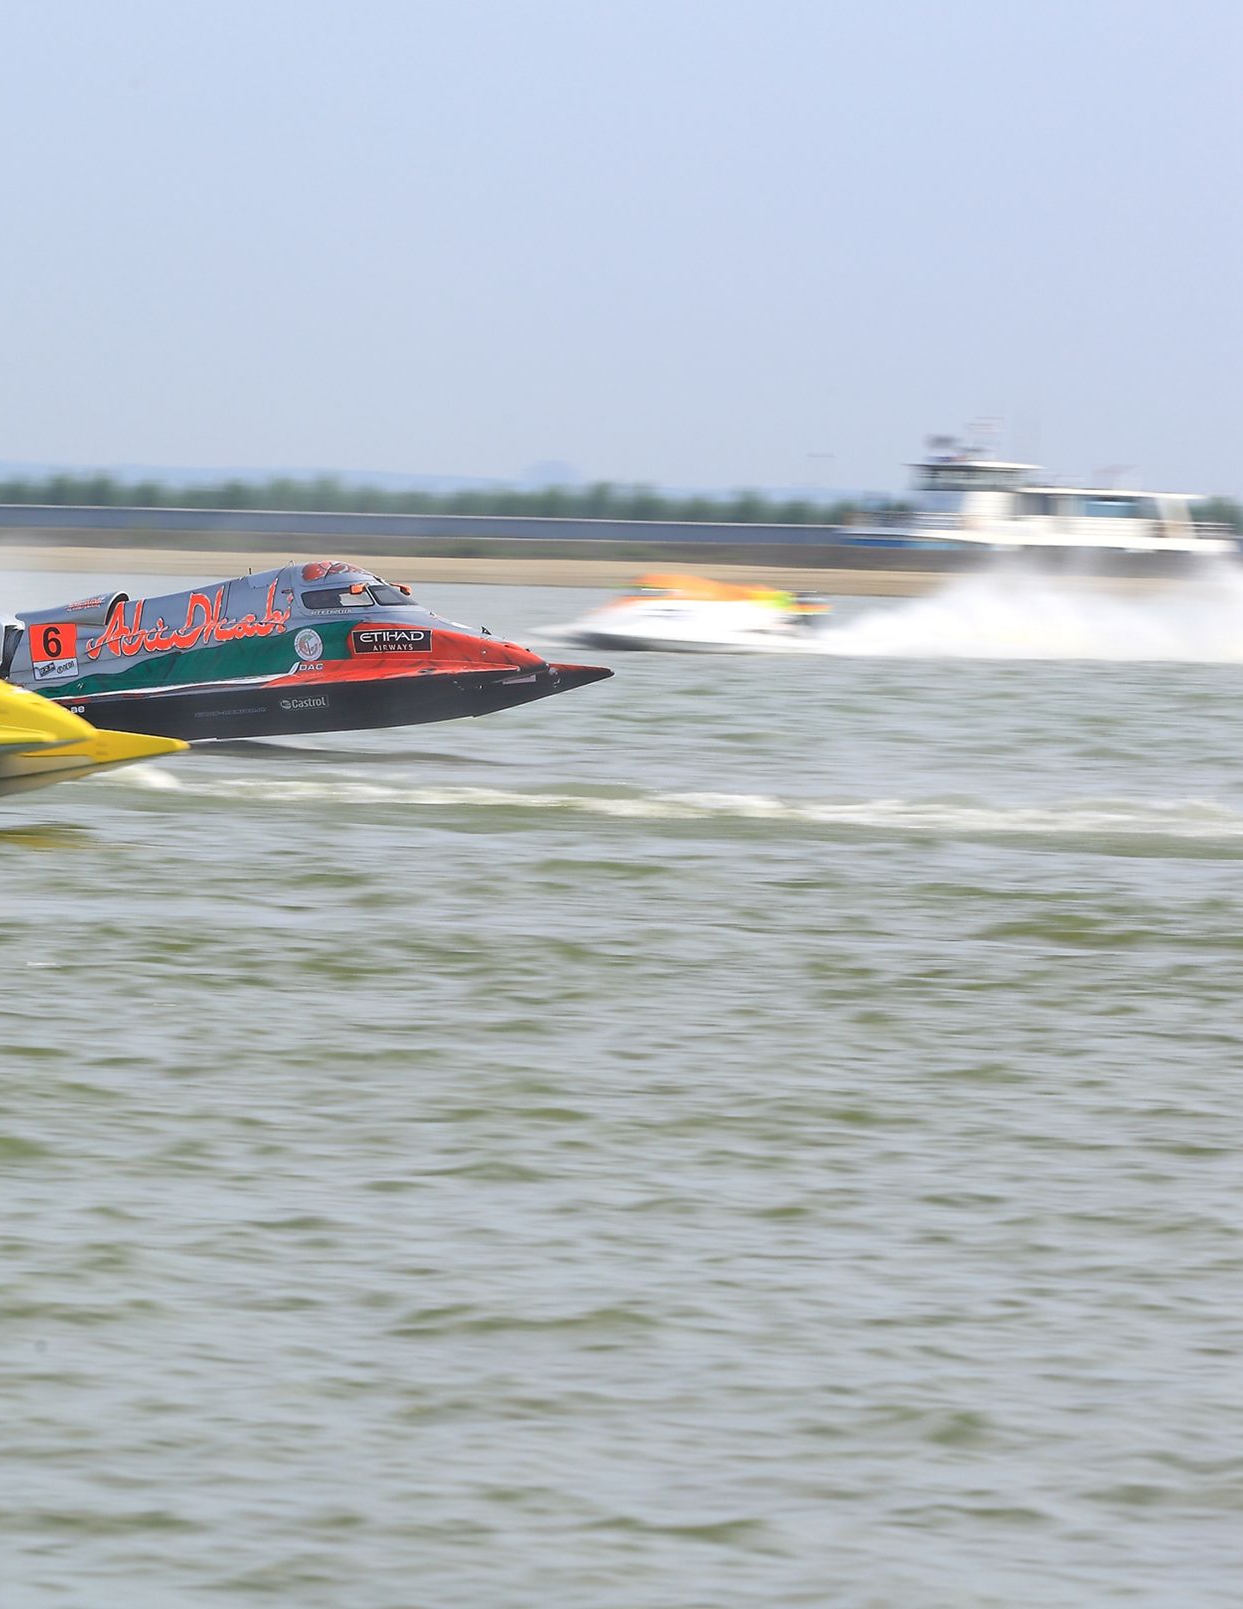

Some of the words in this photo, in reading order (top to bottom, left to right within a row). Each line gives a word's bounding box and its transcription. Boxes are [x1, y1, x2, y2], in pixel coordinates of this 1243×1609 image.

[85, 598, 169, 661] Abu
[171, 577, 296, 645] Dhabi
[43, 626, 63, 658] 6
[359, 630, 426, 643] ETIHAD
[373, 643, 414, 652] AIRWAYS
[291, 696, 327, 709] Castrol
